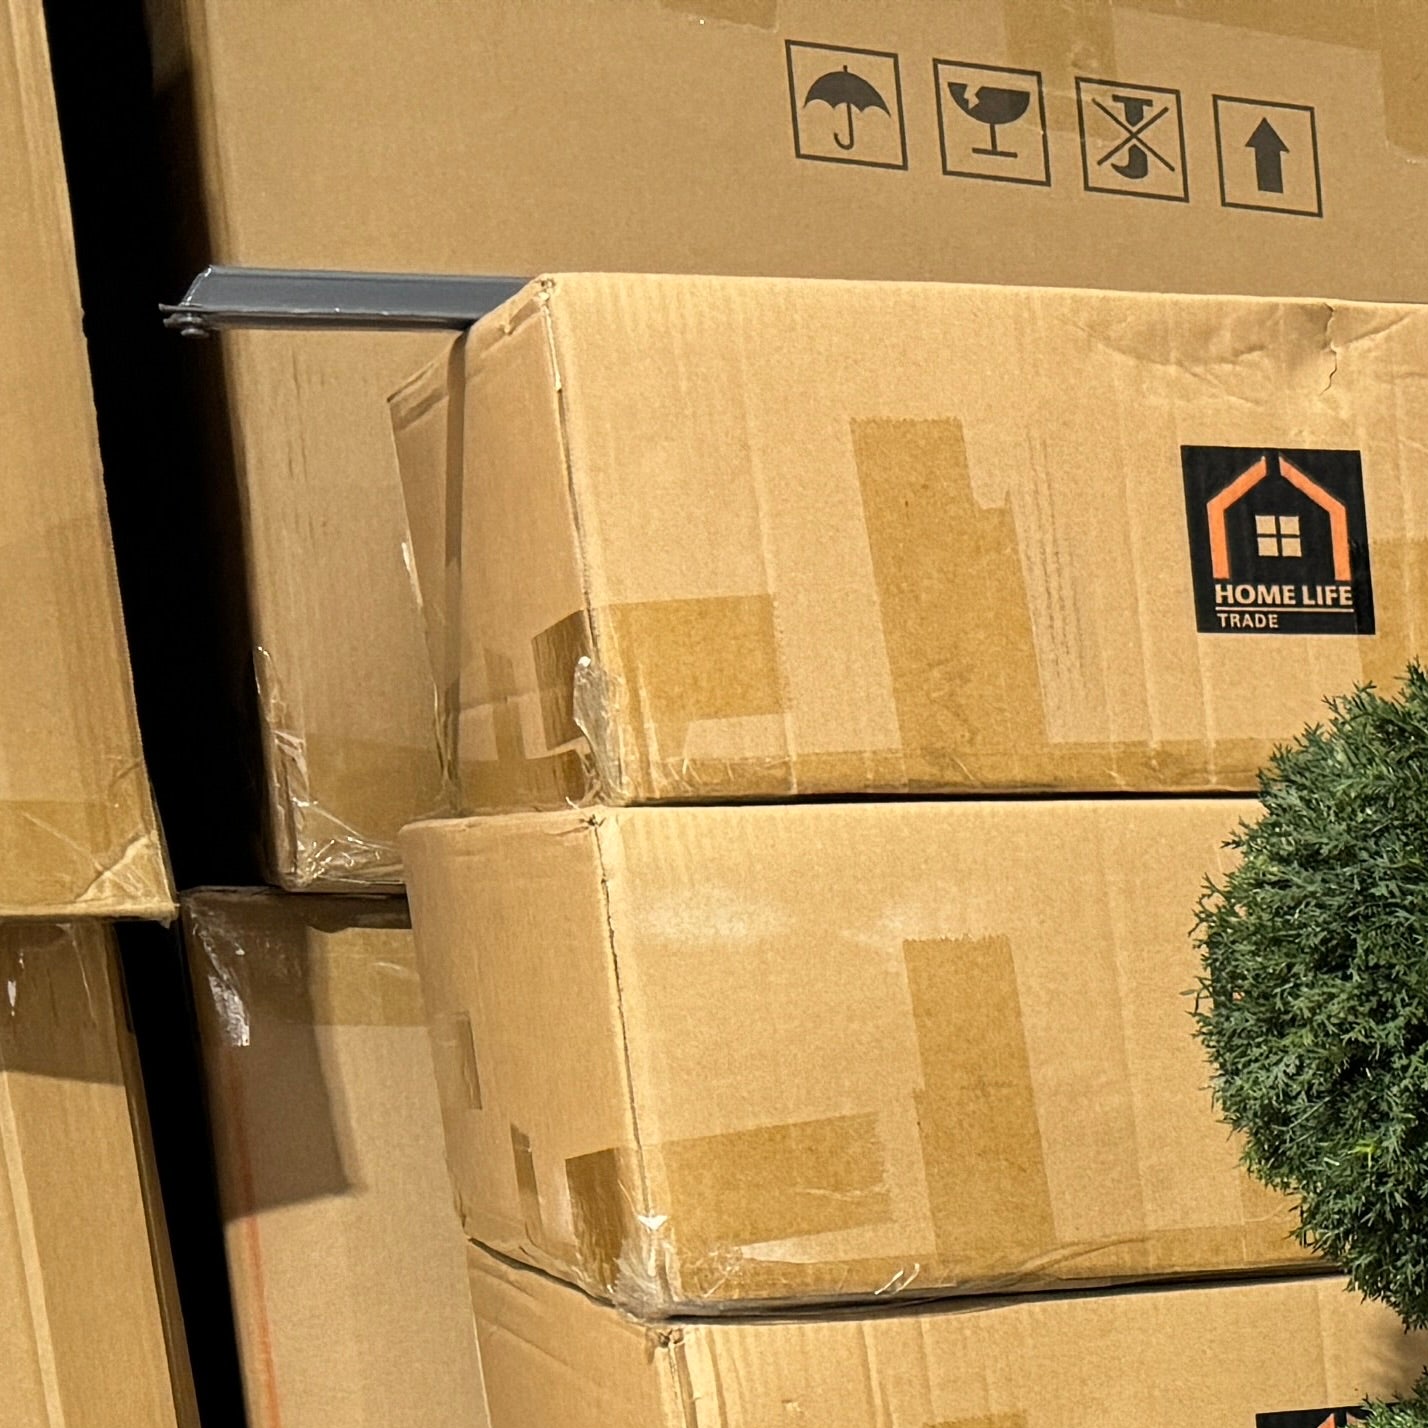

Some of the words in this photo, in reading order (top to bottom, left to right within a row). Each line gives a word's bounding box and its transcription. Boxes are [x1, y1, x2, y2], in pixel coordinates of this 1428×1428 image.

[1215, 584, 1296, 605] HOME
[1302, 585, 1353, 606] LIFE
[1217, 613, 1279, 628] TRADE
